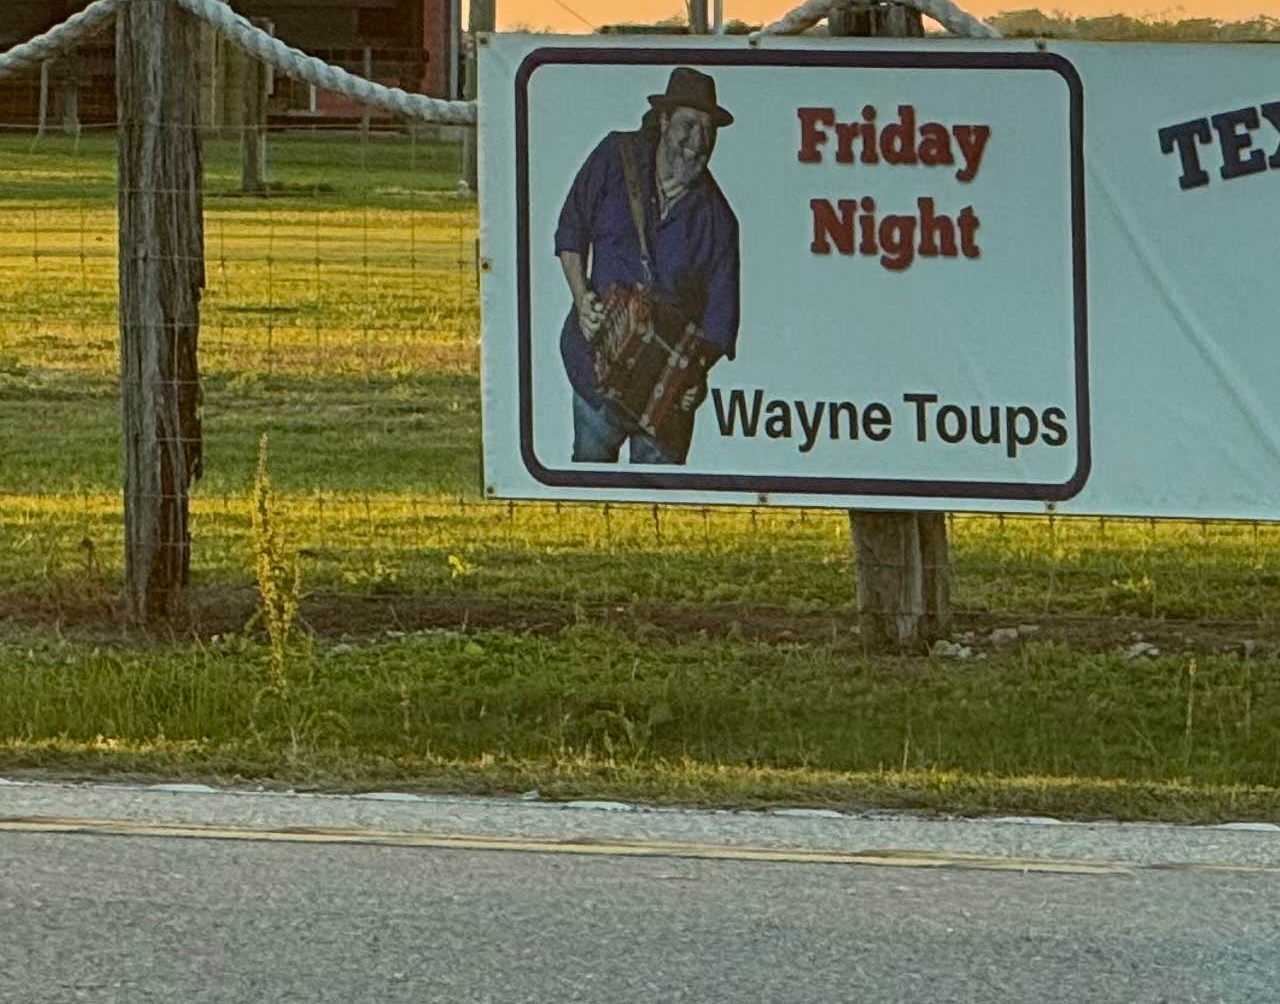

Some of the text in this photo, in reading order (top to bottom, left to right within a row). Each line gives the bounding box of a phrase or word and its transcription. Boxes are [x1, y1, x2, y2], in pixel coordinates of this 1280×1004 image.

[796, 105, 991, 182] Friday
[810, 196, 981, 271] Night
[712, 389, 1069, 458] Wayne Toups
